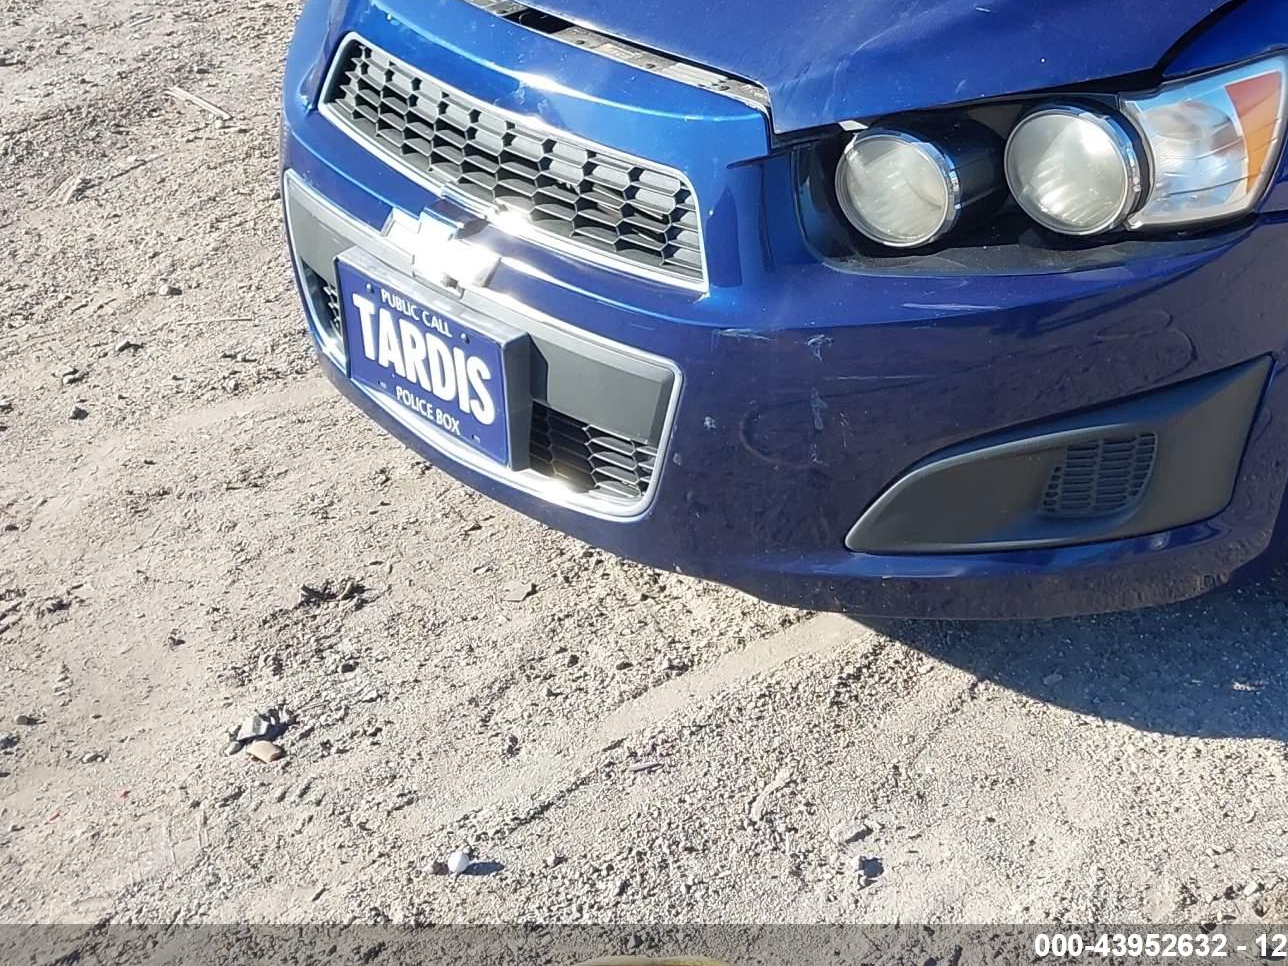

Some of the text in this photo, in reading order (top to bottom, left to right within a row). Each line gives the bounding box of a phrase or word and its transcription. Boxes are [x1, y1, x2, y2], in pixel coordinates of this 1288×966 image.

[380, 288, 452, 338] PUBLIC CALL
[352, 293, 495, 425] TARDIS
[395, 386, 461, 435] POLICE BOX
